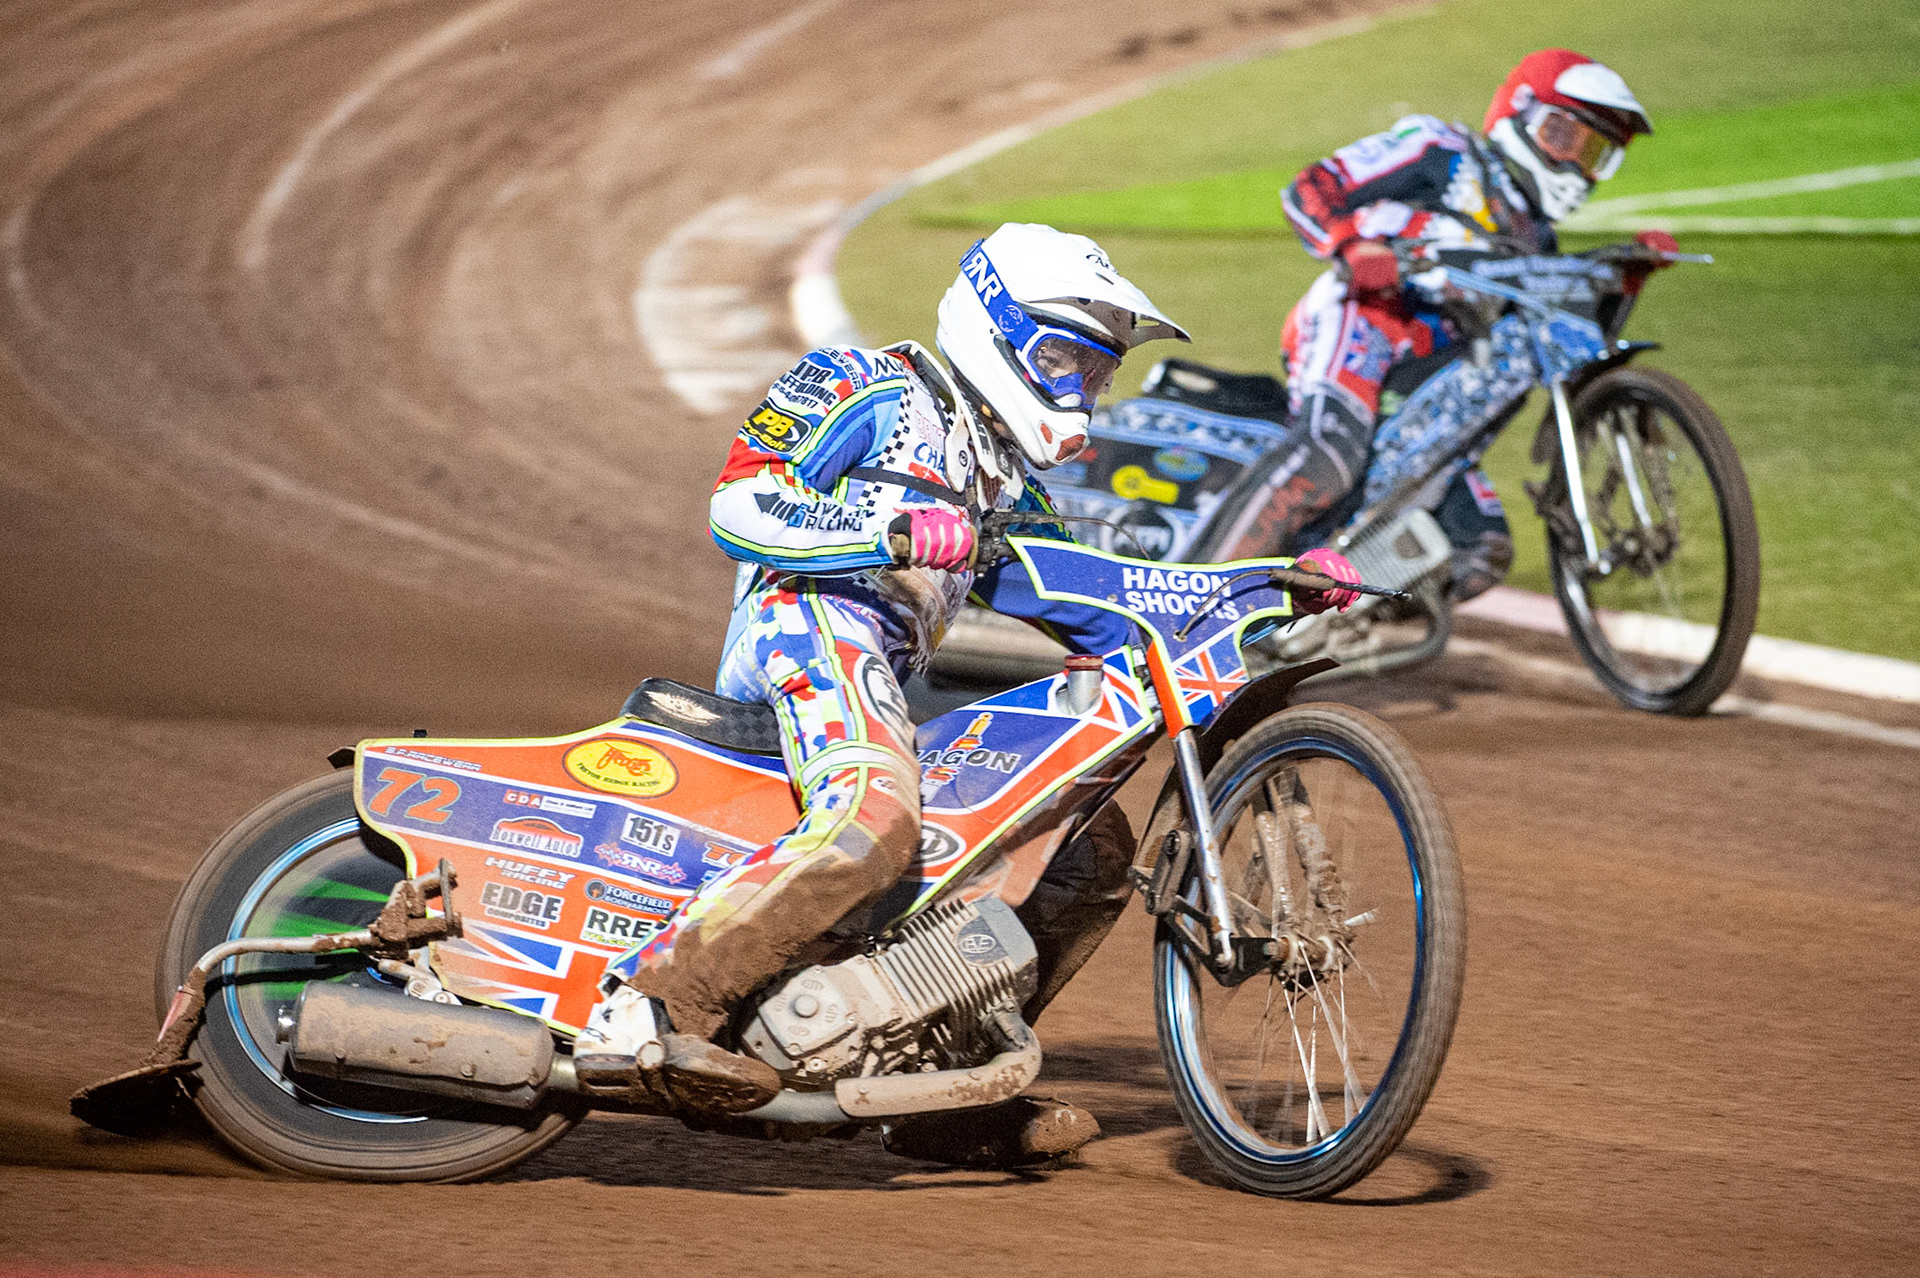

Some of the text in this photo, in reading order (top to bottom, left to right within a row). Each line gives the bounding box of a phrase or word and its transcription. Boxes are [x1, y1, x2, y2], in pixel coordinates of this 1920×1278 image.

[752, 408, 794, 438] PB
[1122, 567, 1232, 598] HAGON
[917, 750, 1022, 774] AGON
[367, 767, 462, 825] 72
[484, 856, 578, 886] HUFFY
[500, 870, 567, 890] RACING
[481, 882, 563, 921] EDGE
[607, 885, 674, 908] FORCEFIELD
[587, 908, 652, 938] RRE
